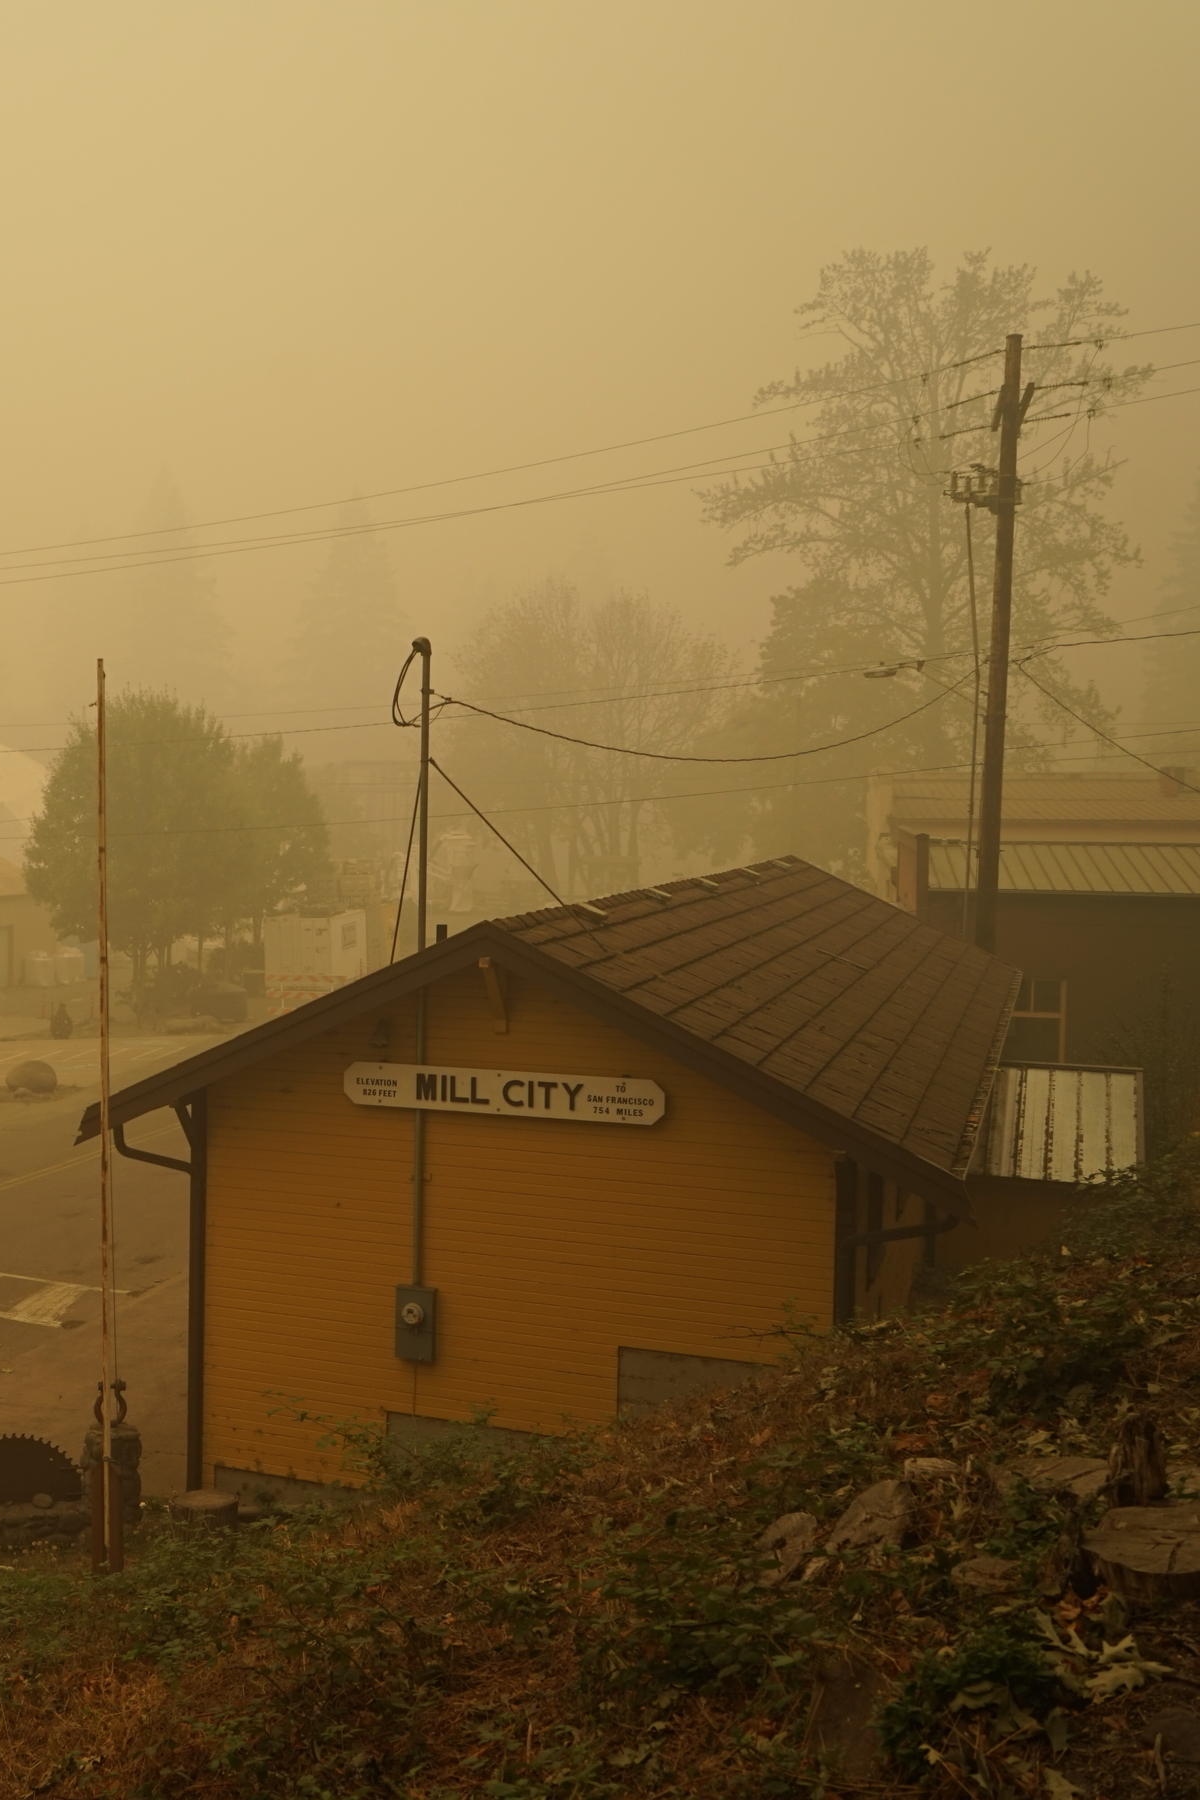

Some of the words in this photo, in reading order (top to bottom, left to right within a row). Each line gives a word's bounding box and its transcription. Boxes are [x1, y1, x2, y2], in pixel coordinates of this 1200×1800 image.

[356, 1077, 398, 1087] ELEVATION
[378, 1089, 397, 1098] FEET
[416, 1073, 490, 1104] MILL
[502, 1079, 584, 1111] CITY
[615, 1085, 626, 1093] TO
[586, 1094, 604, 1104] SAN
[605, 1096, 655, 1106] FRANCISCO
[593, 1106, 610, 1115] 754
[616, 1108, 644, 1117] MILES
